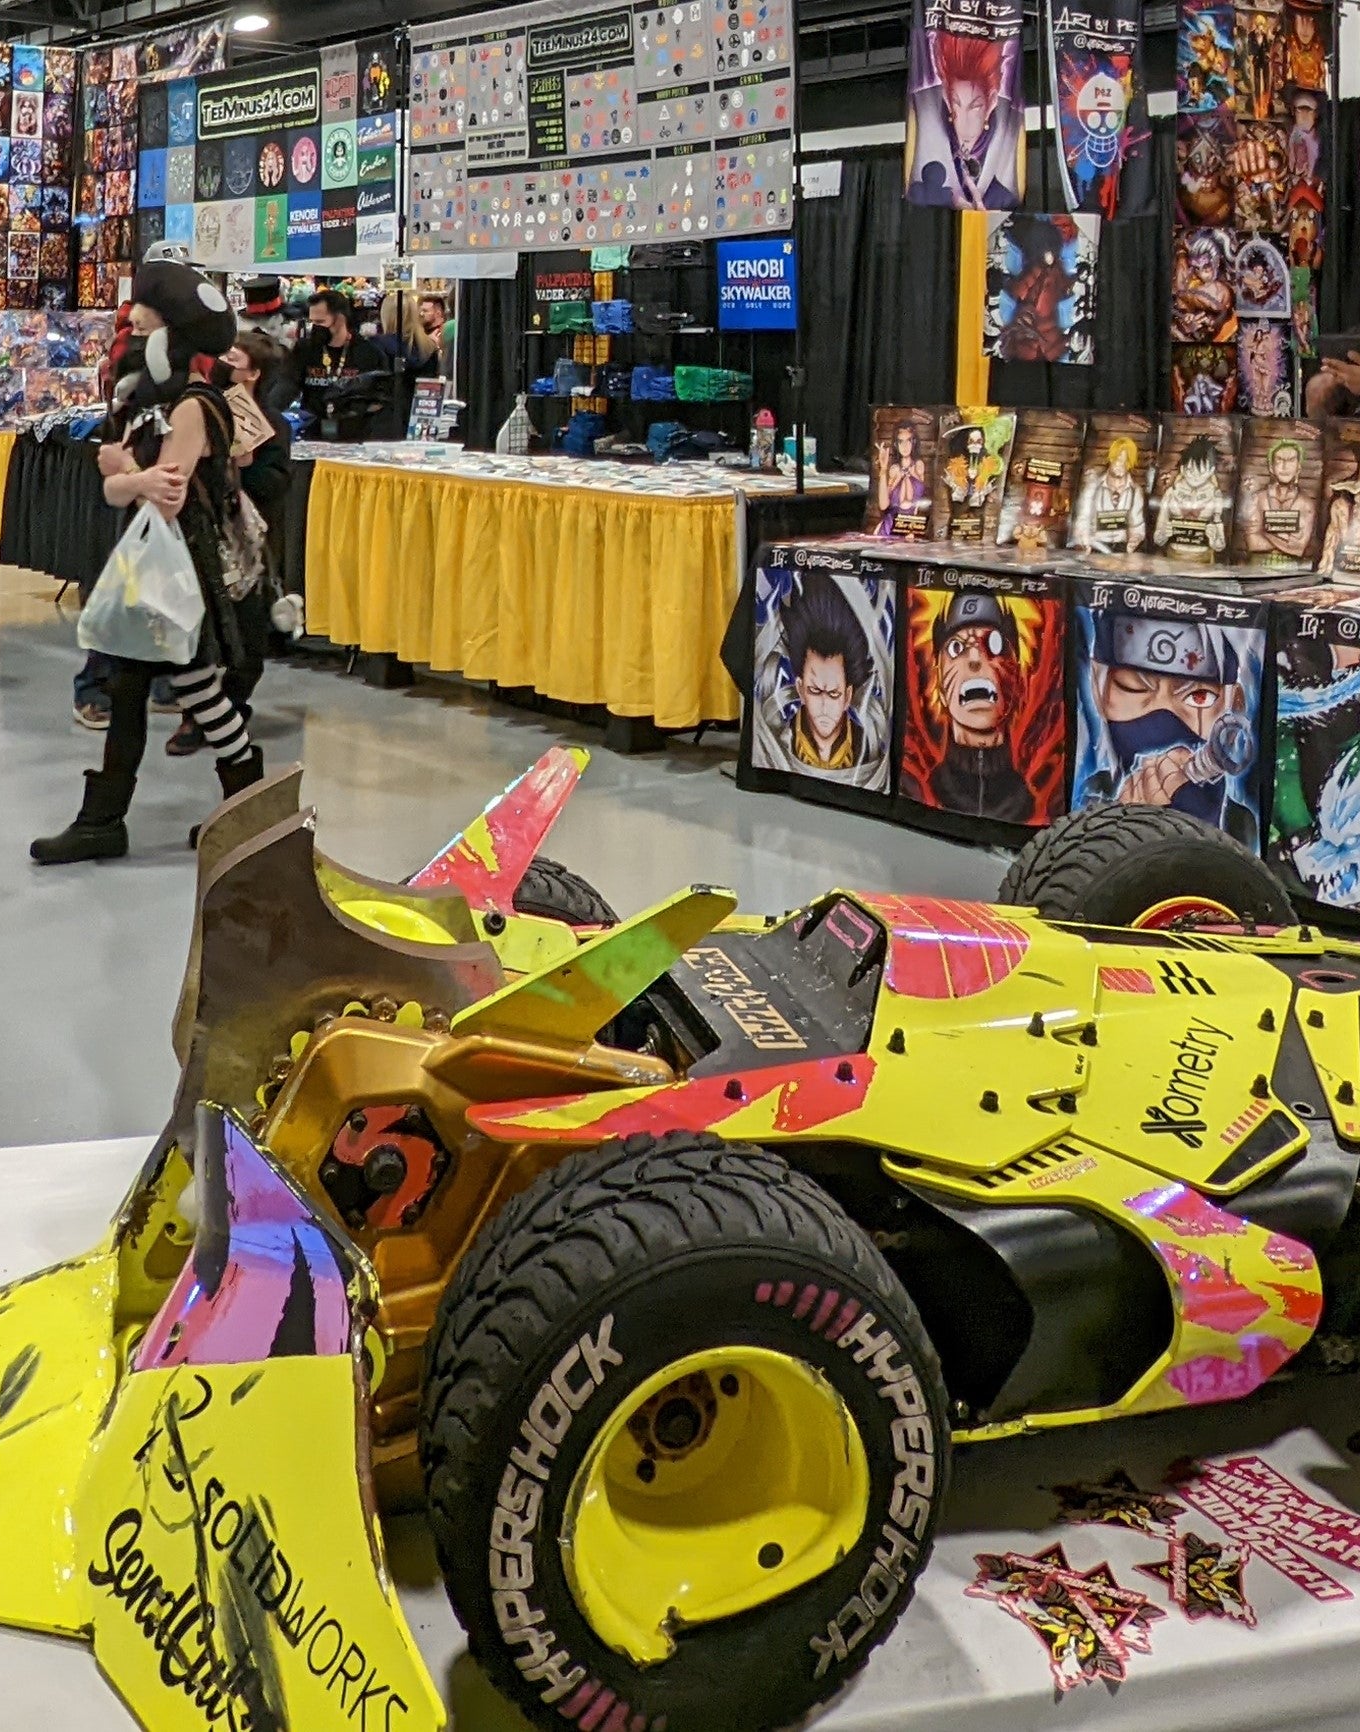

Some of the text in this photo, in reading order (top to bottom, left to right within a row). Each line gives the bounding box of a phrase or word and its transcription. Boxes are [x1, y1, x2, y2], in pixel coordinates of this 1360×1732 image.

[960, 1, 980, 14] BY
[985, 2, 1016, 17] PEZ
[1094, 20, 1109, 33] BY
[1117, 20, 1138, 33] PE
[289, 207, 319, 222] KENOBI
[286, 222, 322, 237] SKYWALKER
[726, 258, 784, 279] KENOBI
[535, 288, 564, 301] VADER
[721, 285, 792, 301] SKYWALKER
[770, 549, 788, 568] IG:
[916, 568, 935, 588] IG:
[1090, 585, 1250, 622] IG: @NOTORIOUS_PEZ
[1297, 613, 1325, 640] IG:
[1140, 1016, 1234, 1149] Xometry
[810, 1313, 935, 1680] HYPERSHOCK
[488, 1313, 624, 1703] HYPERSHOCK
